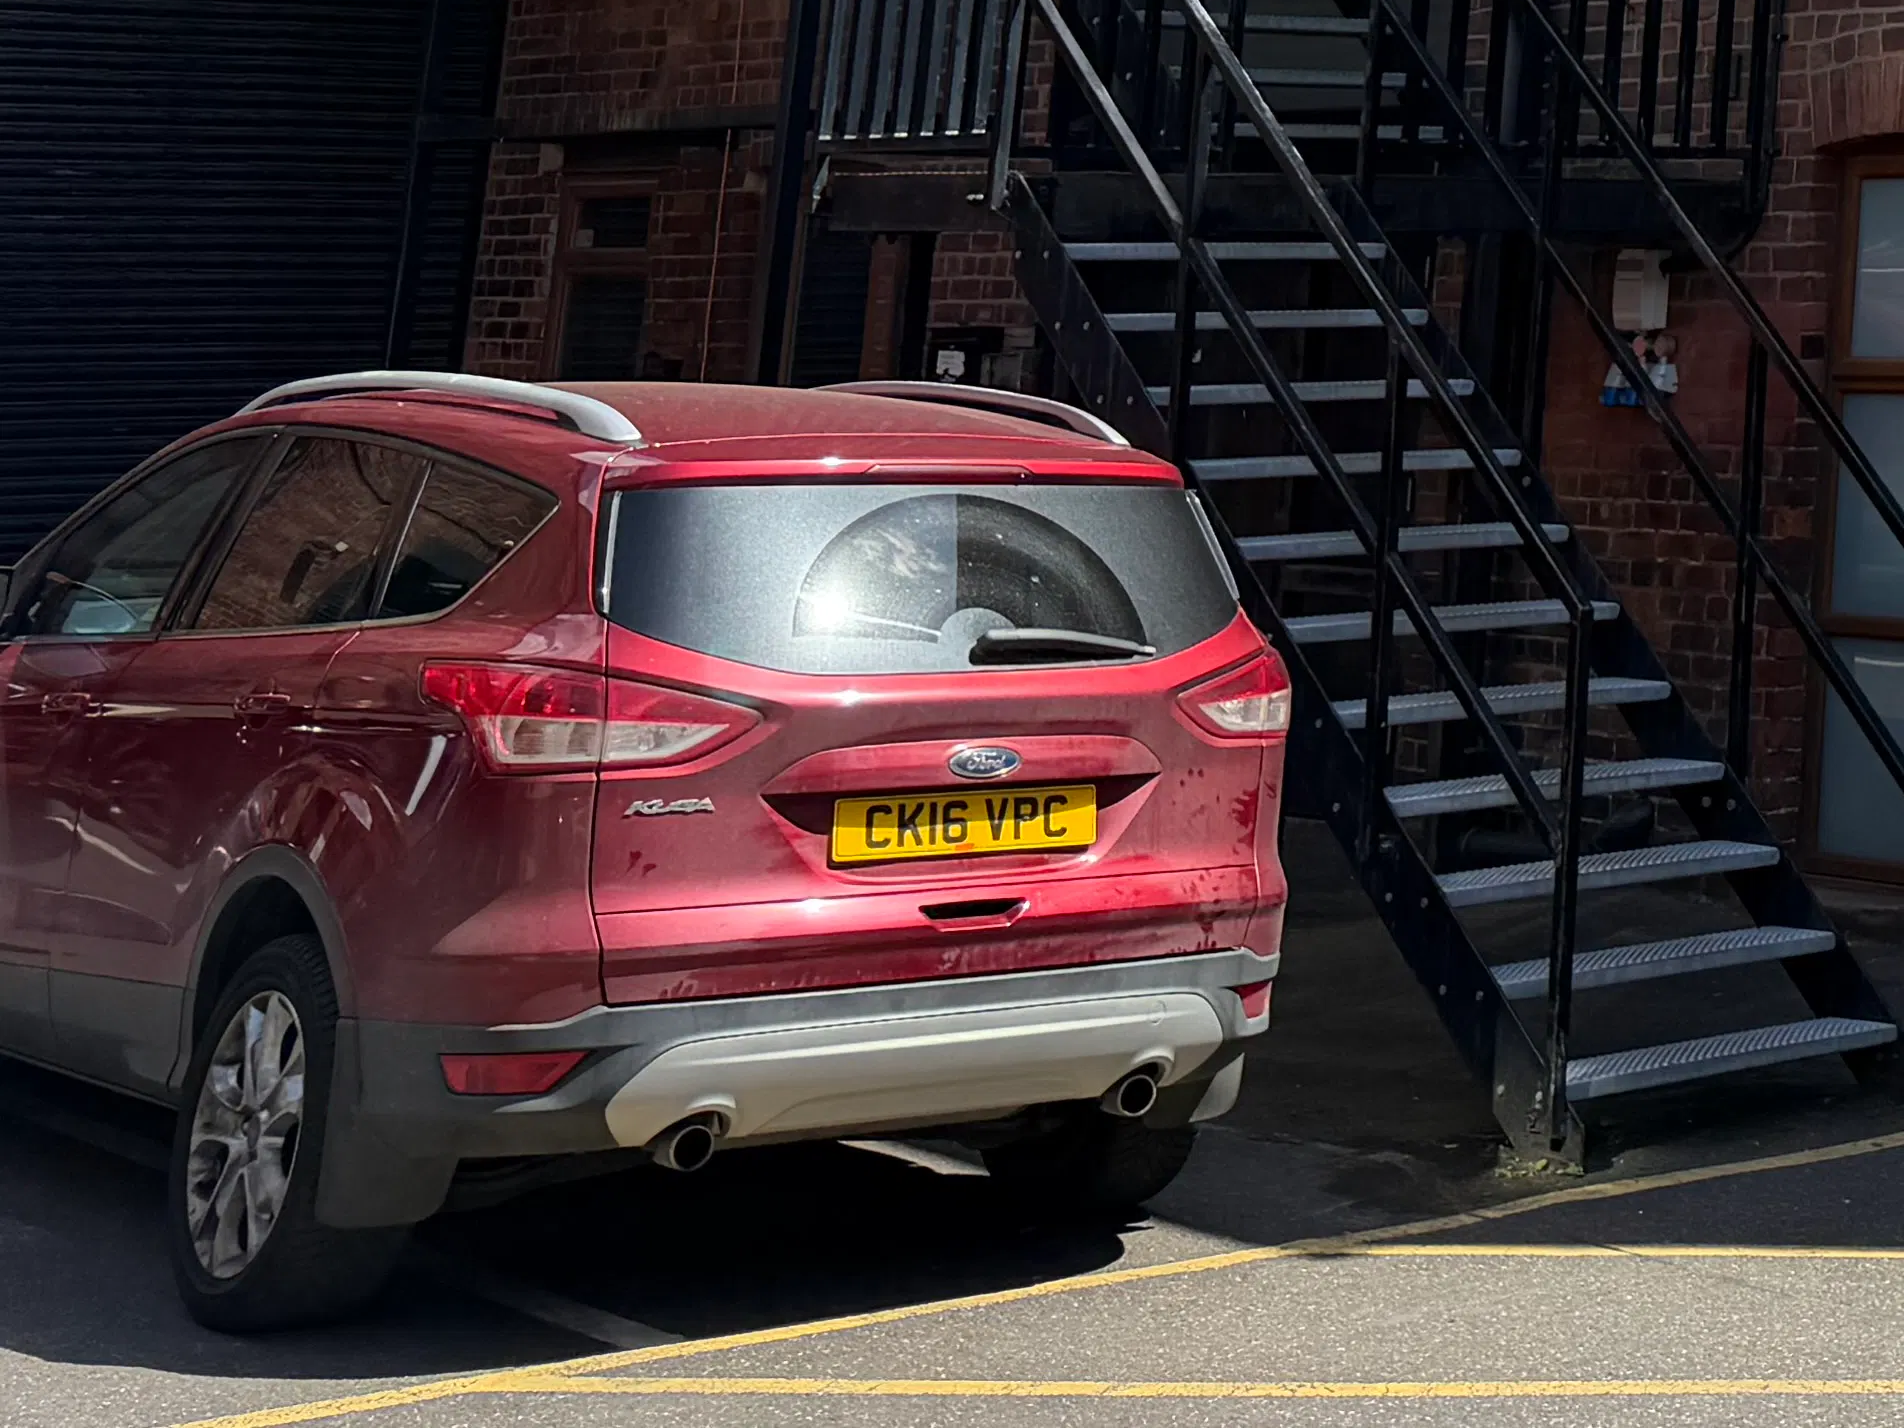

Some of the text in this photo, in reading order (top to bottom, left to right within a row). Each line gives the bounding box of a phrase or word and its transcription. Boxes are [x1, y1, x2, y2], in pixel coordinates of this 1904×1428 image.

[966, 748, 1007, 771] Ford
[623, 796, 716, 819] KUGA
[865, 795, 1068, 849] CK16 VPC
